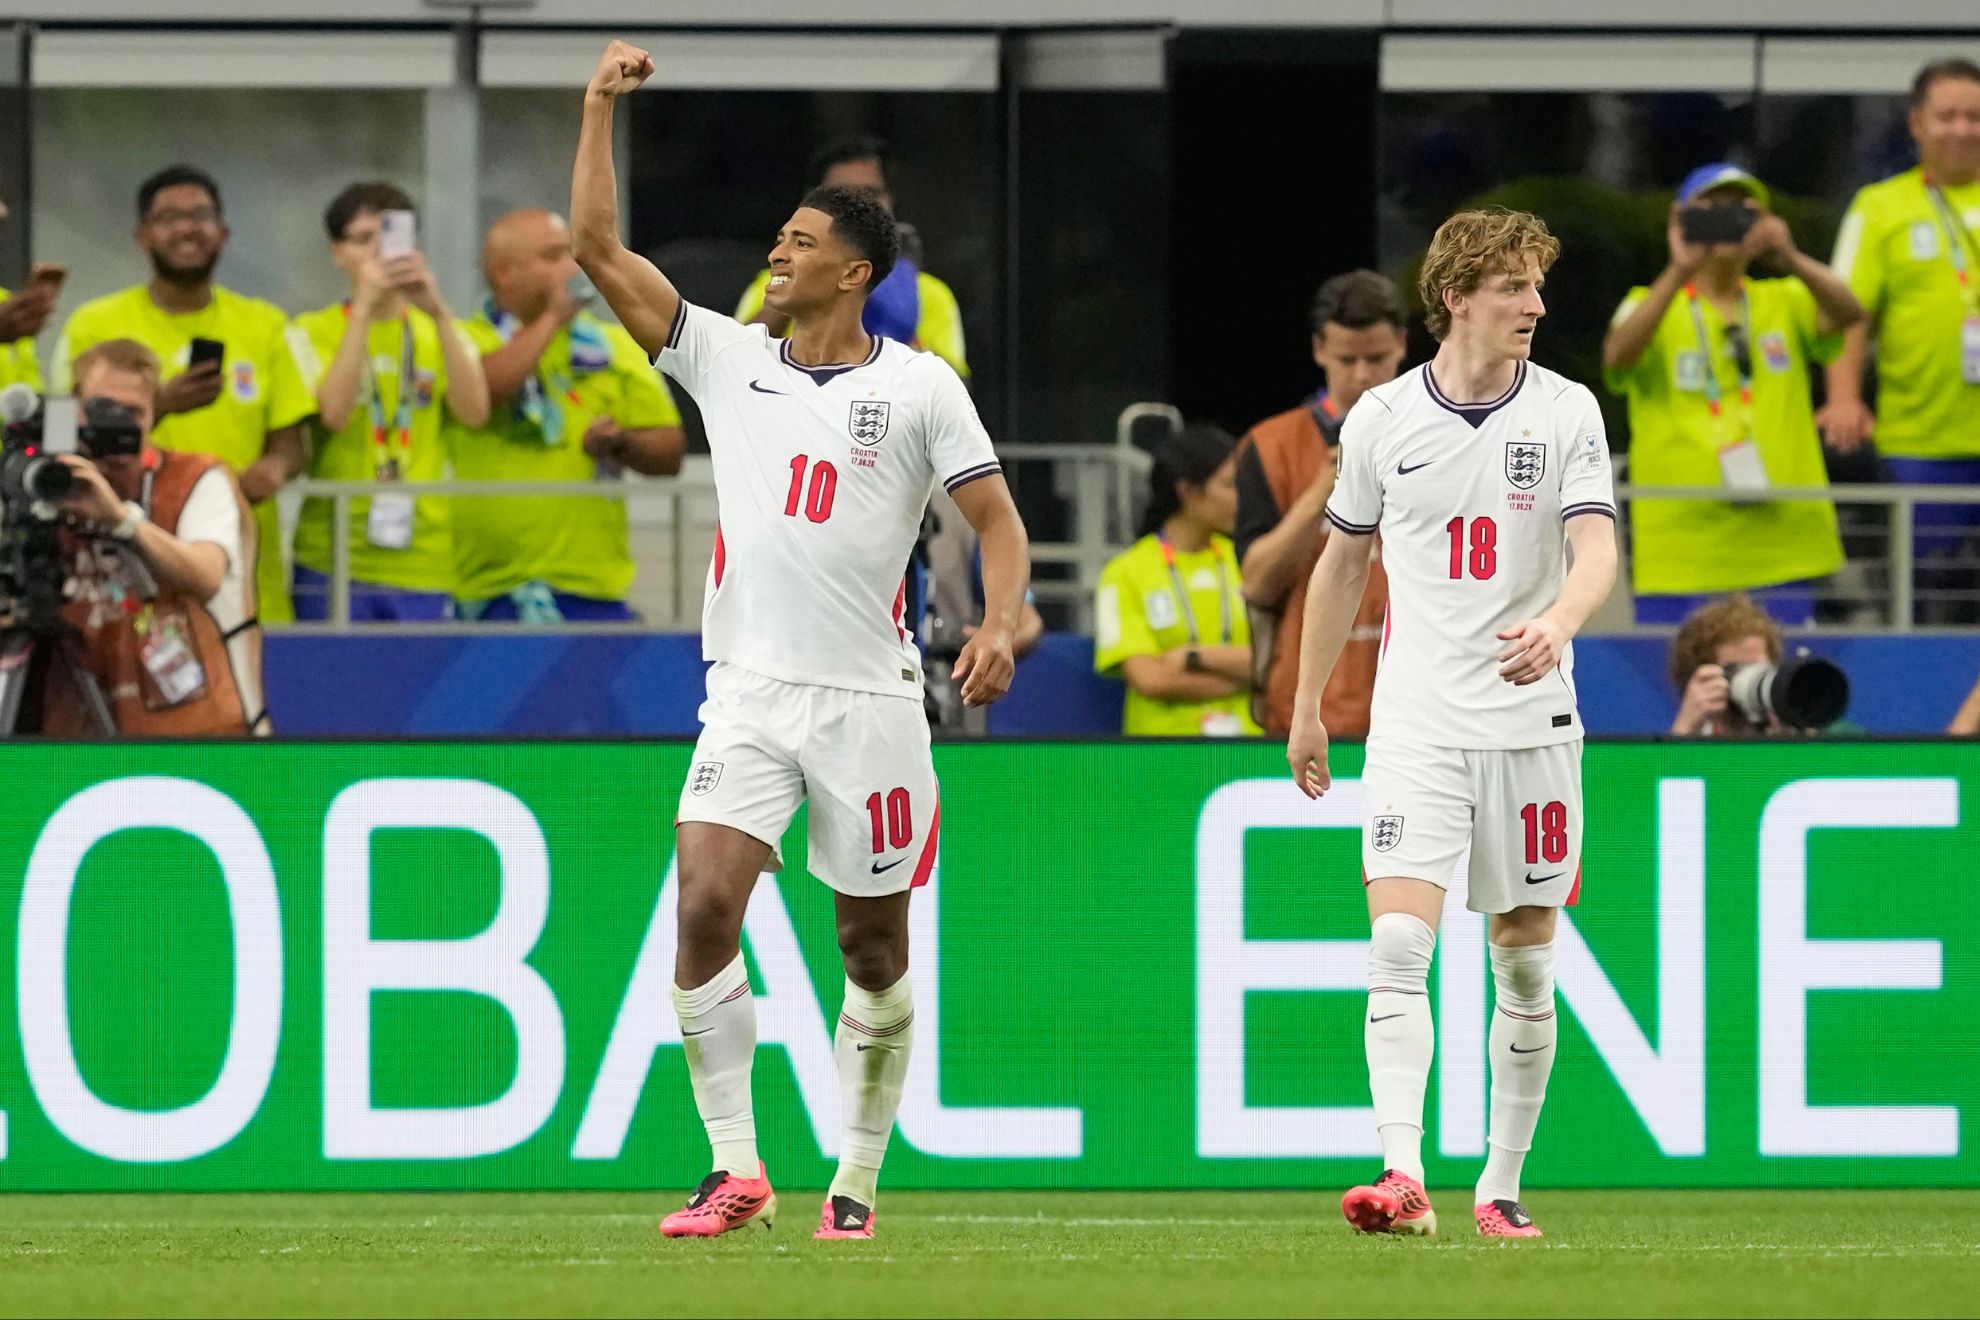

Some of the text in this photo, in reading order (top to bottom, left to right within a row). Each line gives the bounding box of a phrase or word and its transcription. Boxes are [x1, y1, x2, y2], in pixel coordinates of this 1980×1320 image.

[850, 447, 878, 458] CROATIA
[784, 454, 838, 524] 10
[1507, 493, 1535, 502] CROATIA
[1446, 516, 1498, 580] 18
[866, 786, 913, 854] 10
[1520, 801, 1568, 864] 18
[0, 774, 1083, 1162] OBAL
